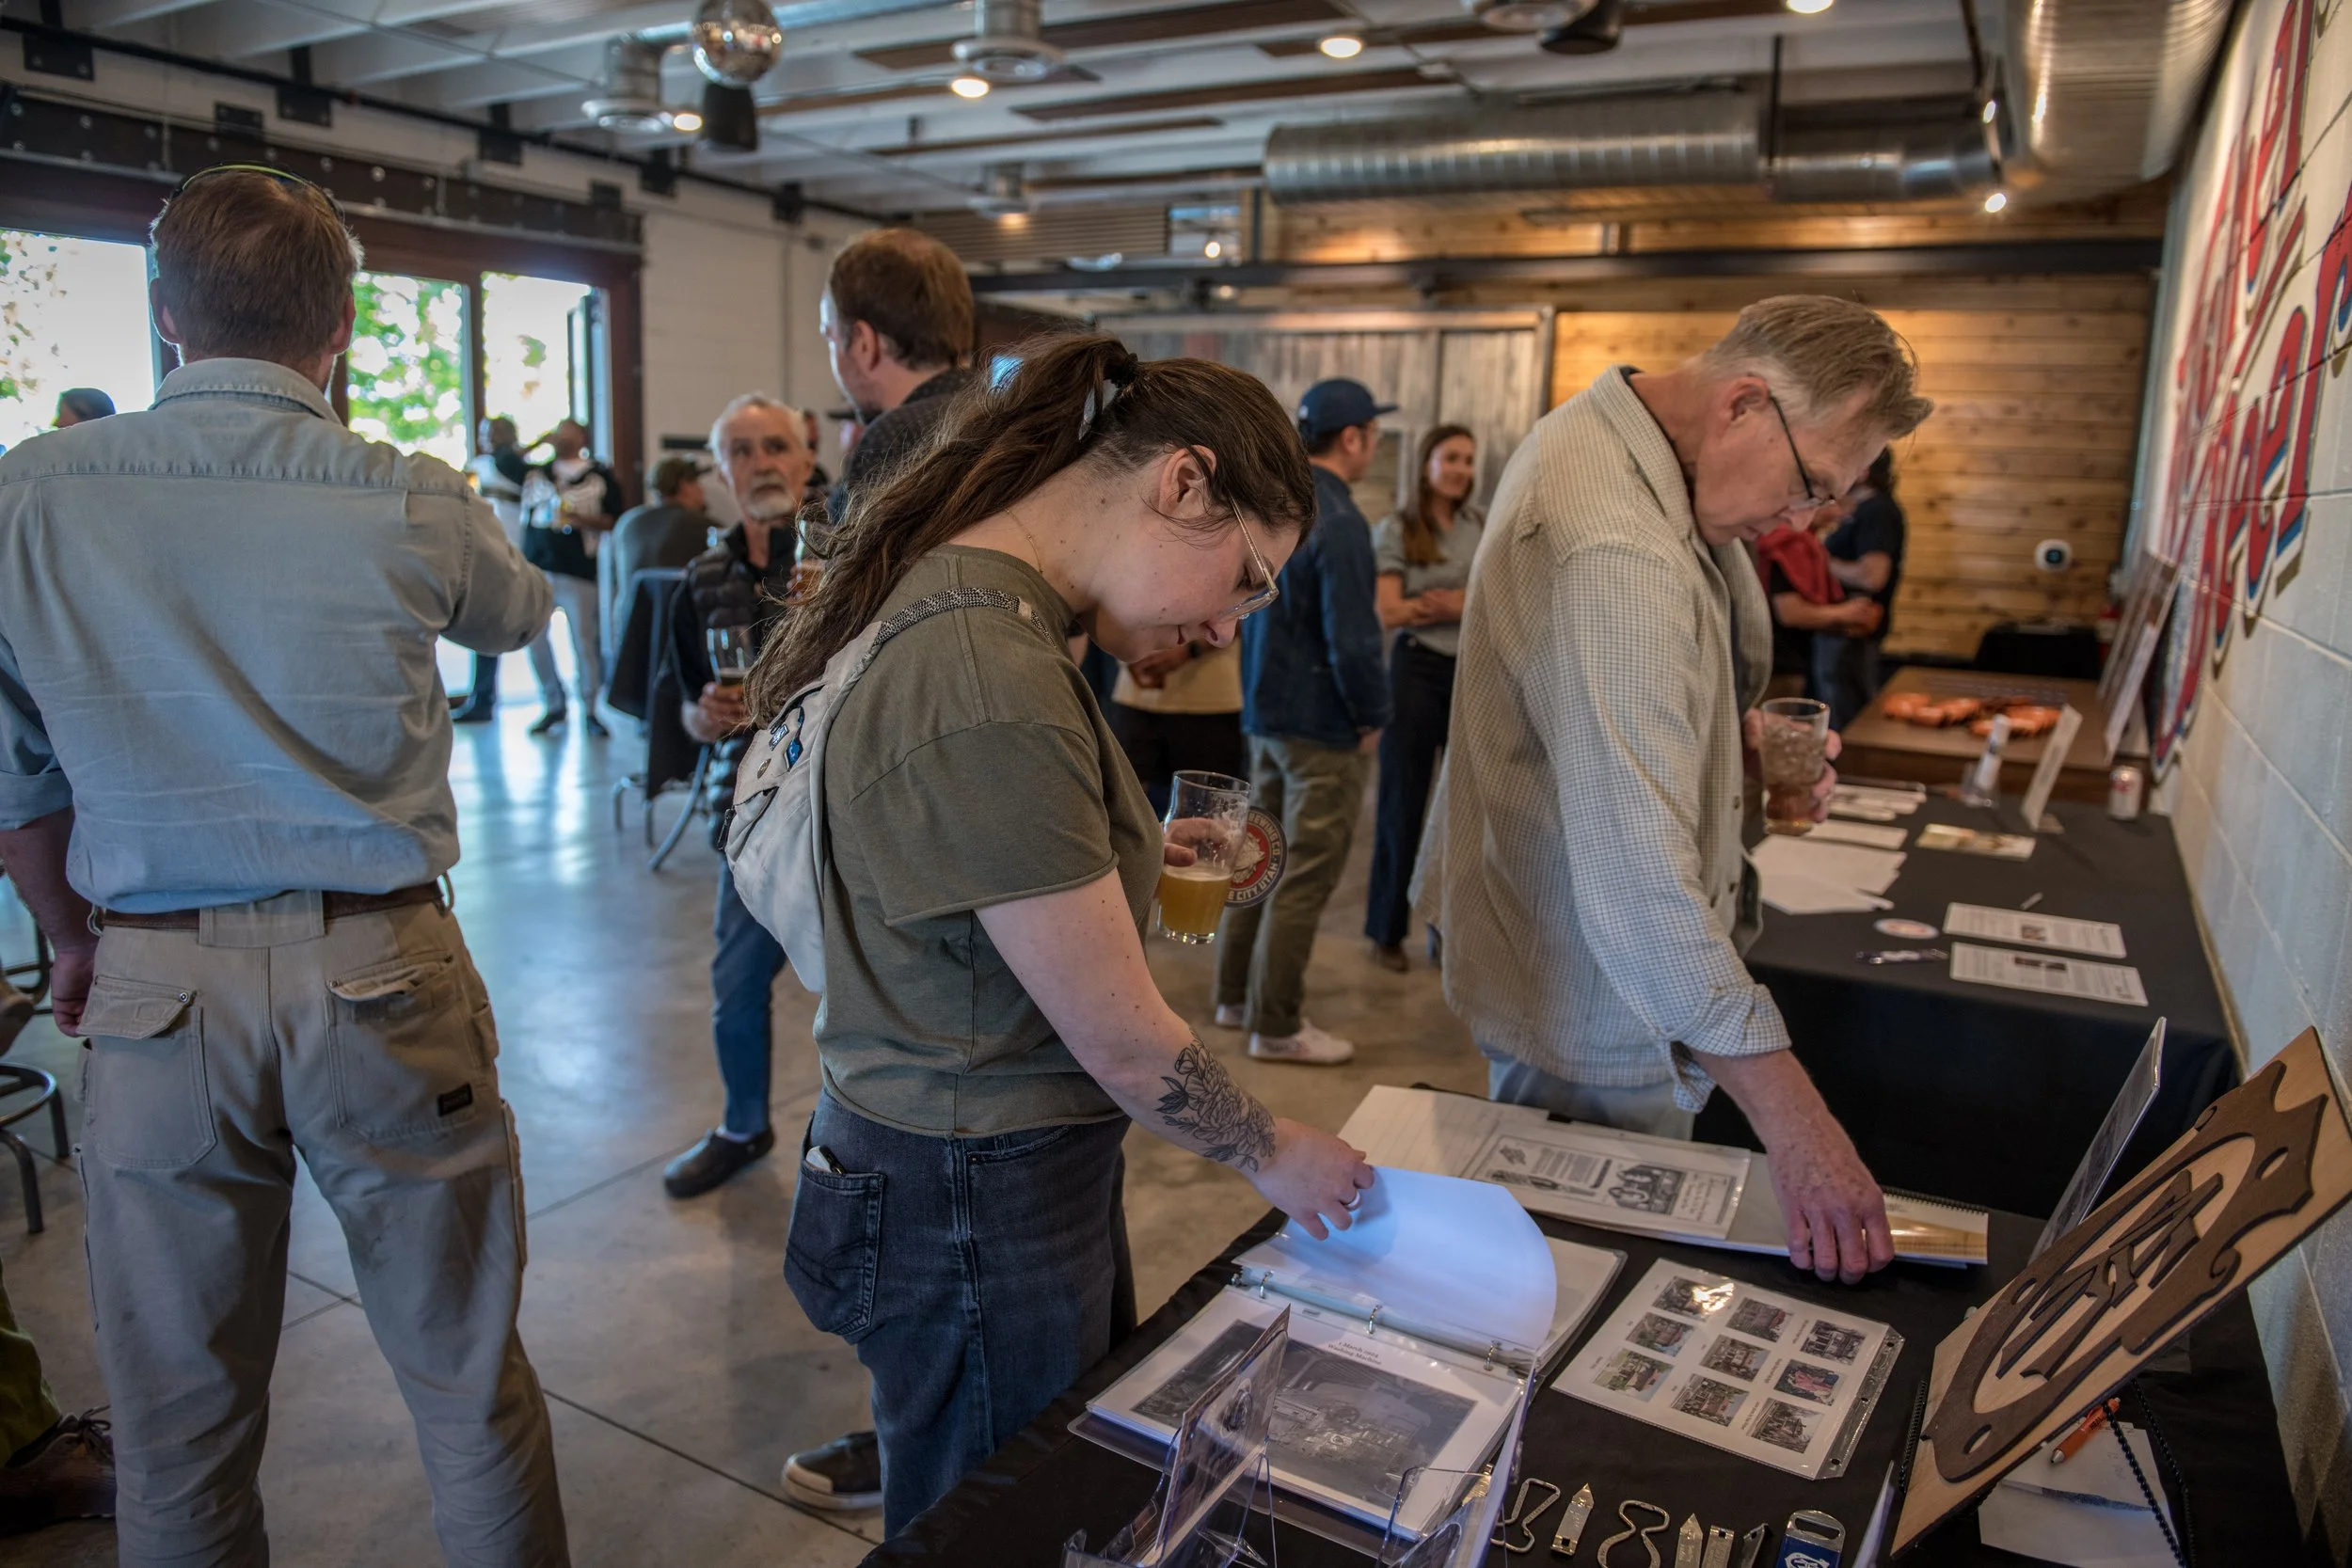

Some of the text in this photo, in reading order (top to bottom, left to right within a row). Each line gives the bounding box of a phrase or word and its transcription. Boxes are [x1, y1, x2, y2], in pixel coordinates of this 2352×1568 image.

[1248, 811, 1279, 840] REWING
[1261, 862, 1279, 890] UTAH
[1327, 1343, 1382, 1365] Washing Machine
[1343, 1341, 1364, 1353] March
